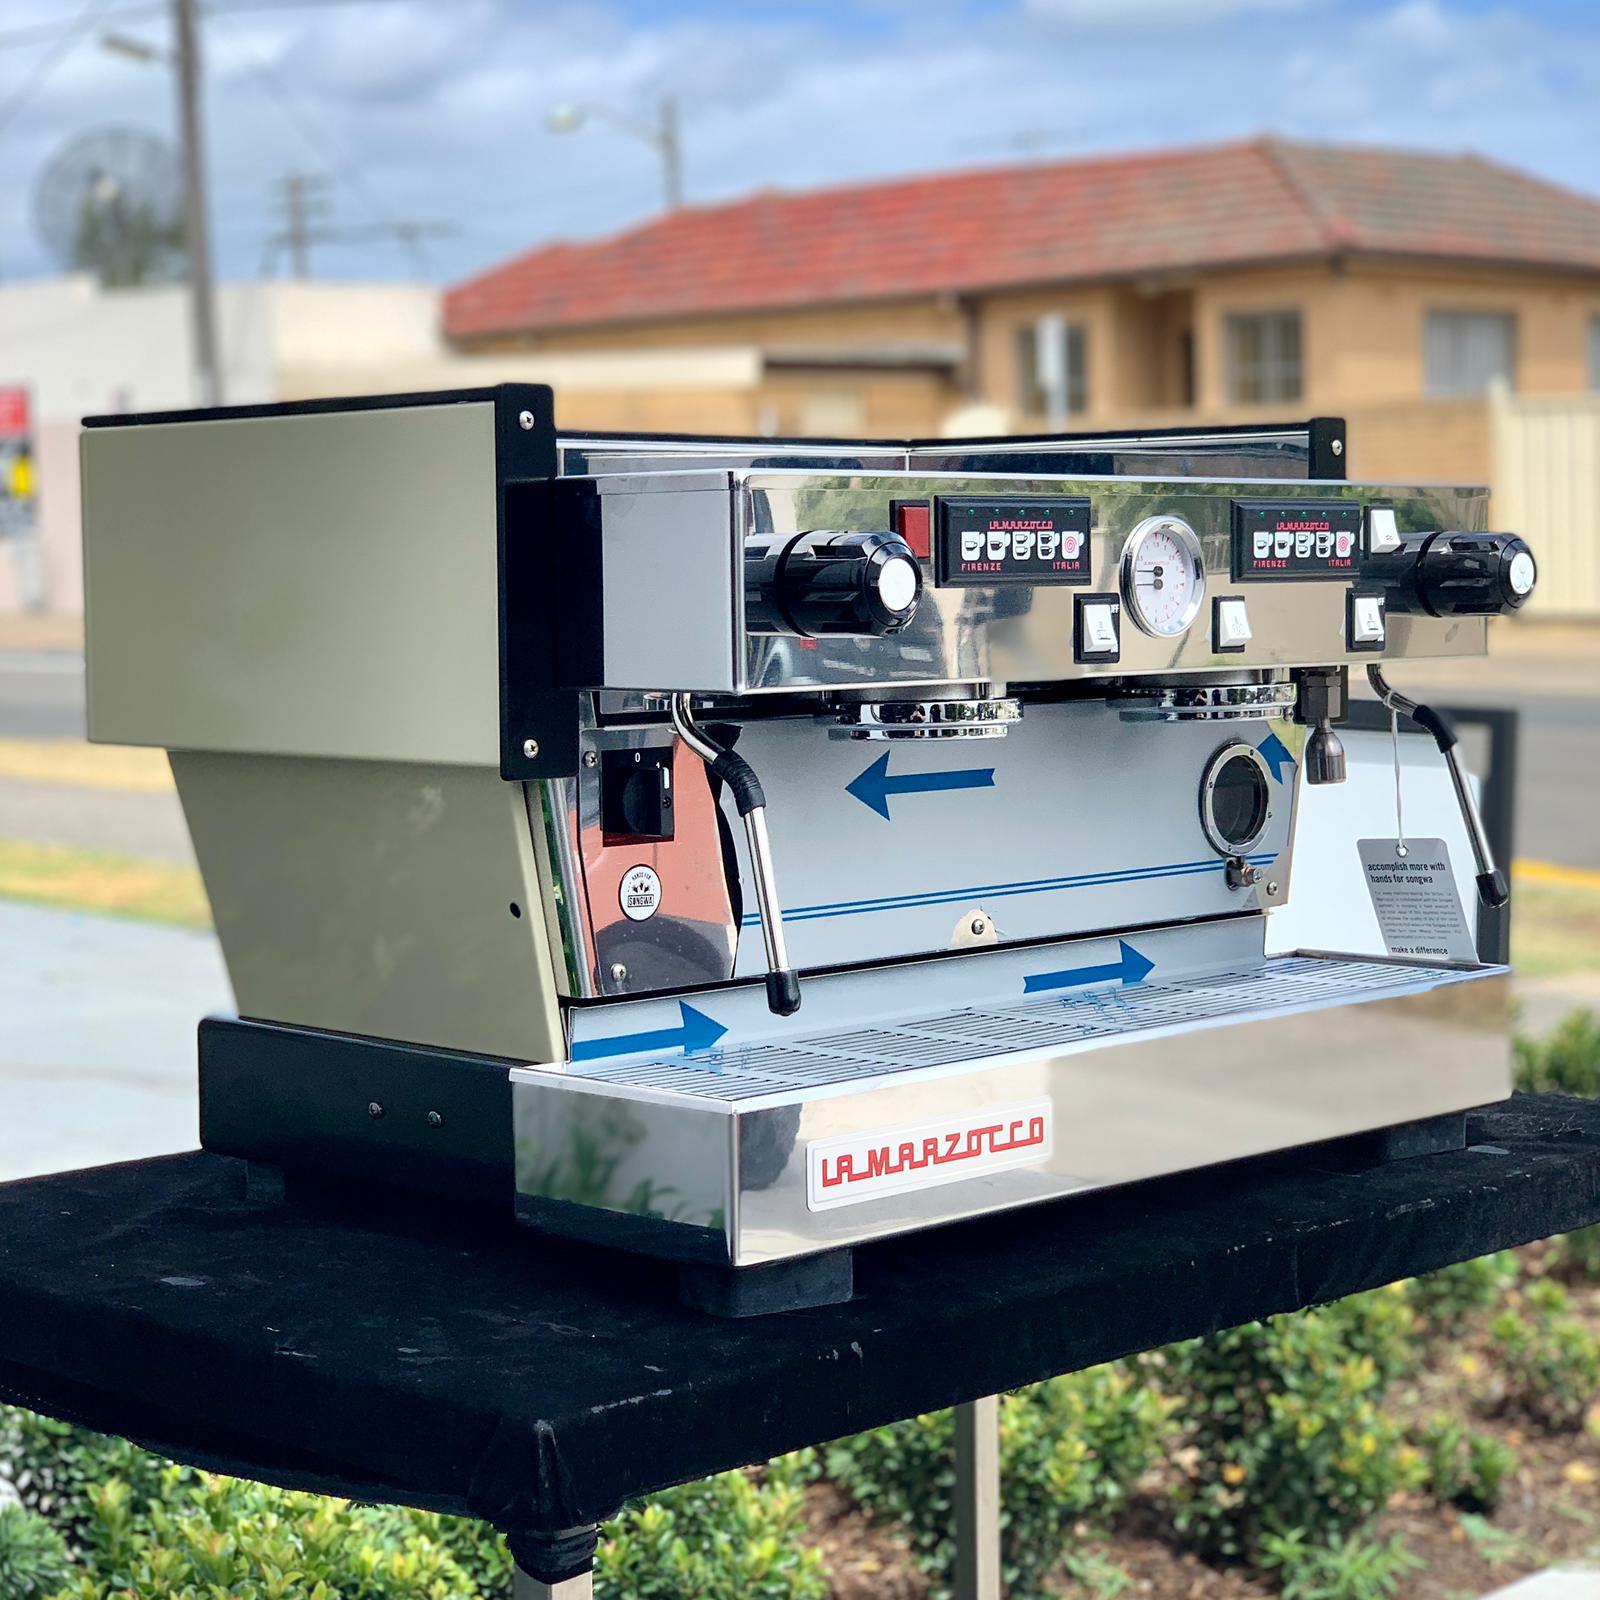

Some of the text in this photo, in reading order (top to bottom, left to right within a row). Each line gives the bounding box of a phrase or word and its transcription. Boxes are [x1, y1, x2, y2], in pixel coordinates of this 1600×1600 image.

[961, 562, 1001, 571] FIRENZE
[1053, 561, 1080, 570] ITALIA
[1253, 560, 1287, 568] FIRENZE
[1328, 559, 1352, 567] ITALIA
[1368, 862, 1446, 871] accomplish more with
[1370, 873, 1433, 885] hands for songwa
[629, 896, 653, 906] SONGWA
[1391, 946, 1409, 954] make
[1414, 946, 1449, 955] difference
[822, 1154, 852, 1187] LA
